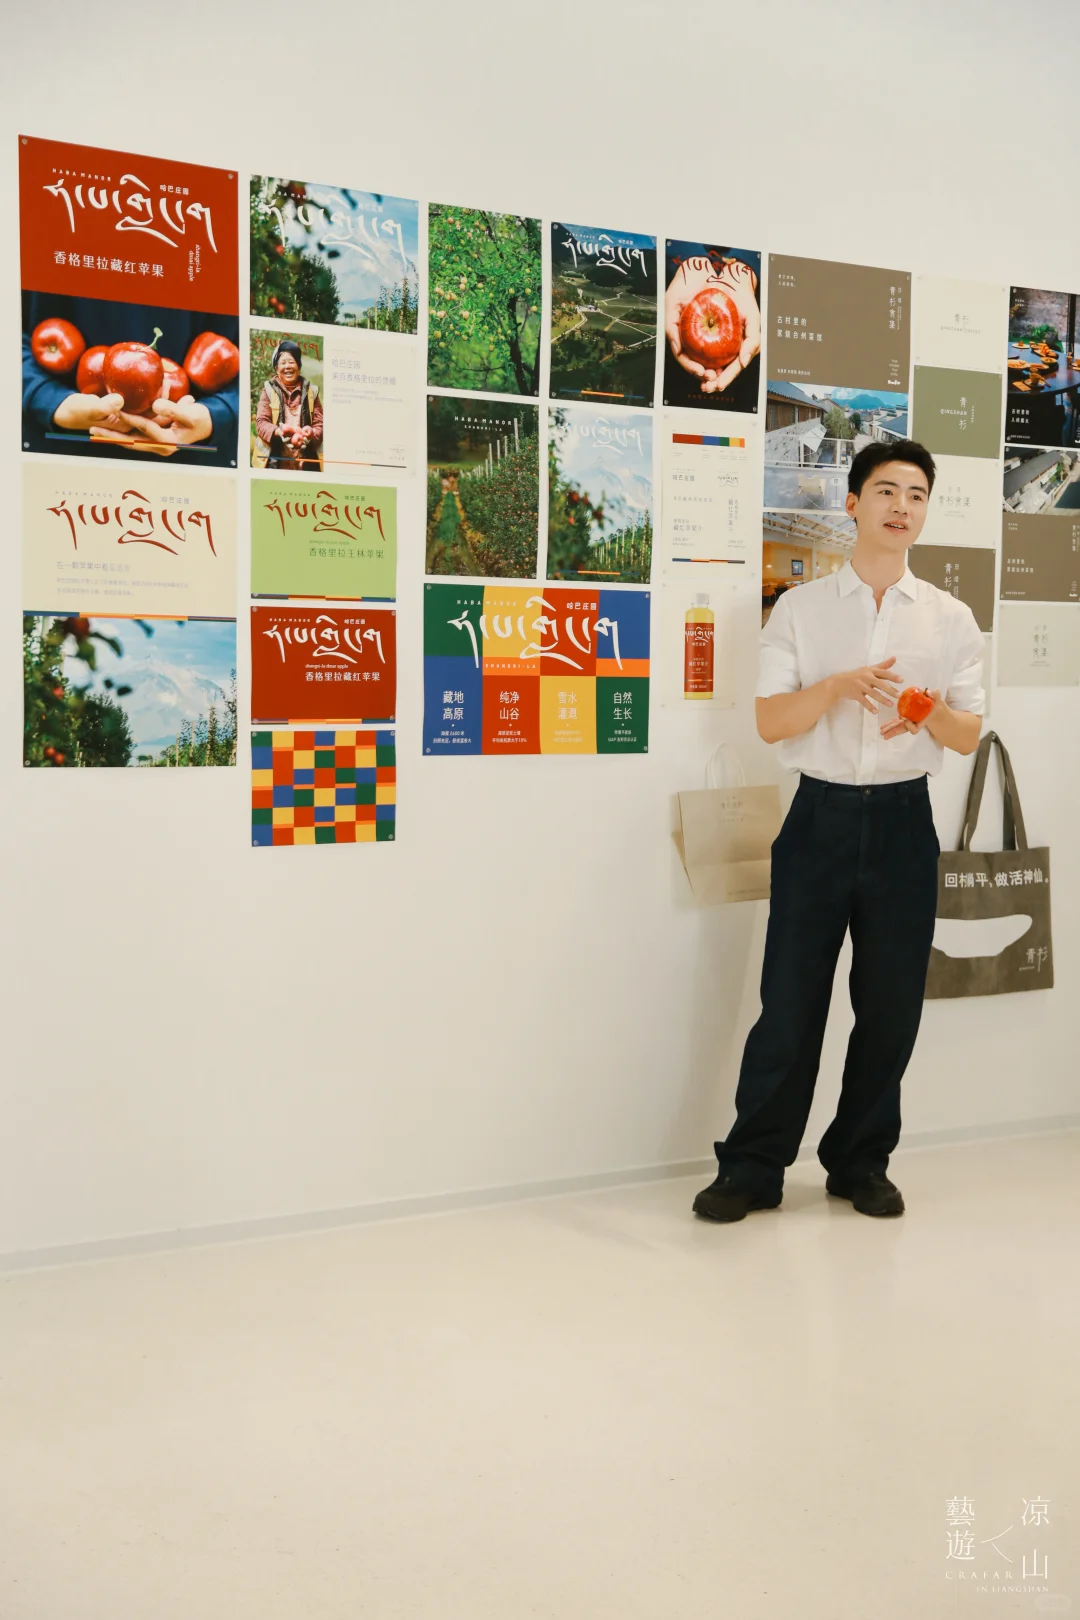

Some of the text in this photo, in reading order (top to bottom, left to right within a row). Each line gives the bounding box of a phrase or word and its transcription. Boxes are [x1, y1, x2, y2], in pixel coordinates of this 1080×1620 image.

[52, 168, 112, 182] HABA MANOR
[159, 184, 190, 195] 哈巴庄园
[53, 250, 165, 278] 香格里拉藏红苹果
[940, 408, 968, 416] QINGSHAN
[567, 602, 597, 611] 哈巴庄园
[305, 671, 381, 682] 香格里拉藏红苹果
[443, 691, 464, 705] 藏地
[499, 691, 520, 705] 纯净
[557, 691, 578, 705] 雪水
[613, 691, 633, 705] 自然
[443, 707, 464, 721] 高原
[499, 707, 520, 721] 山谷
[613, 707, 633, 721] 生长
